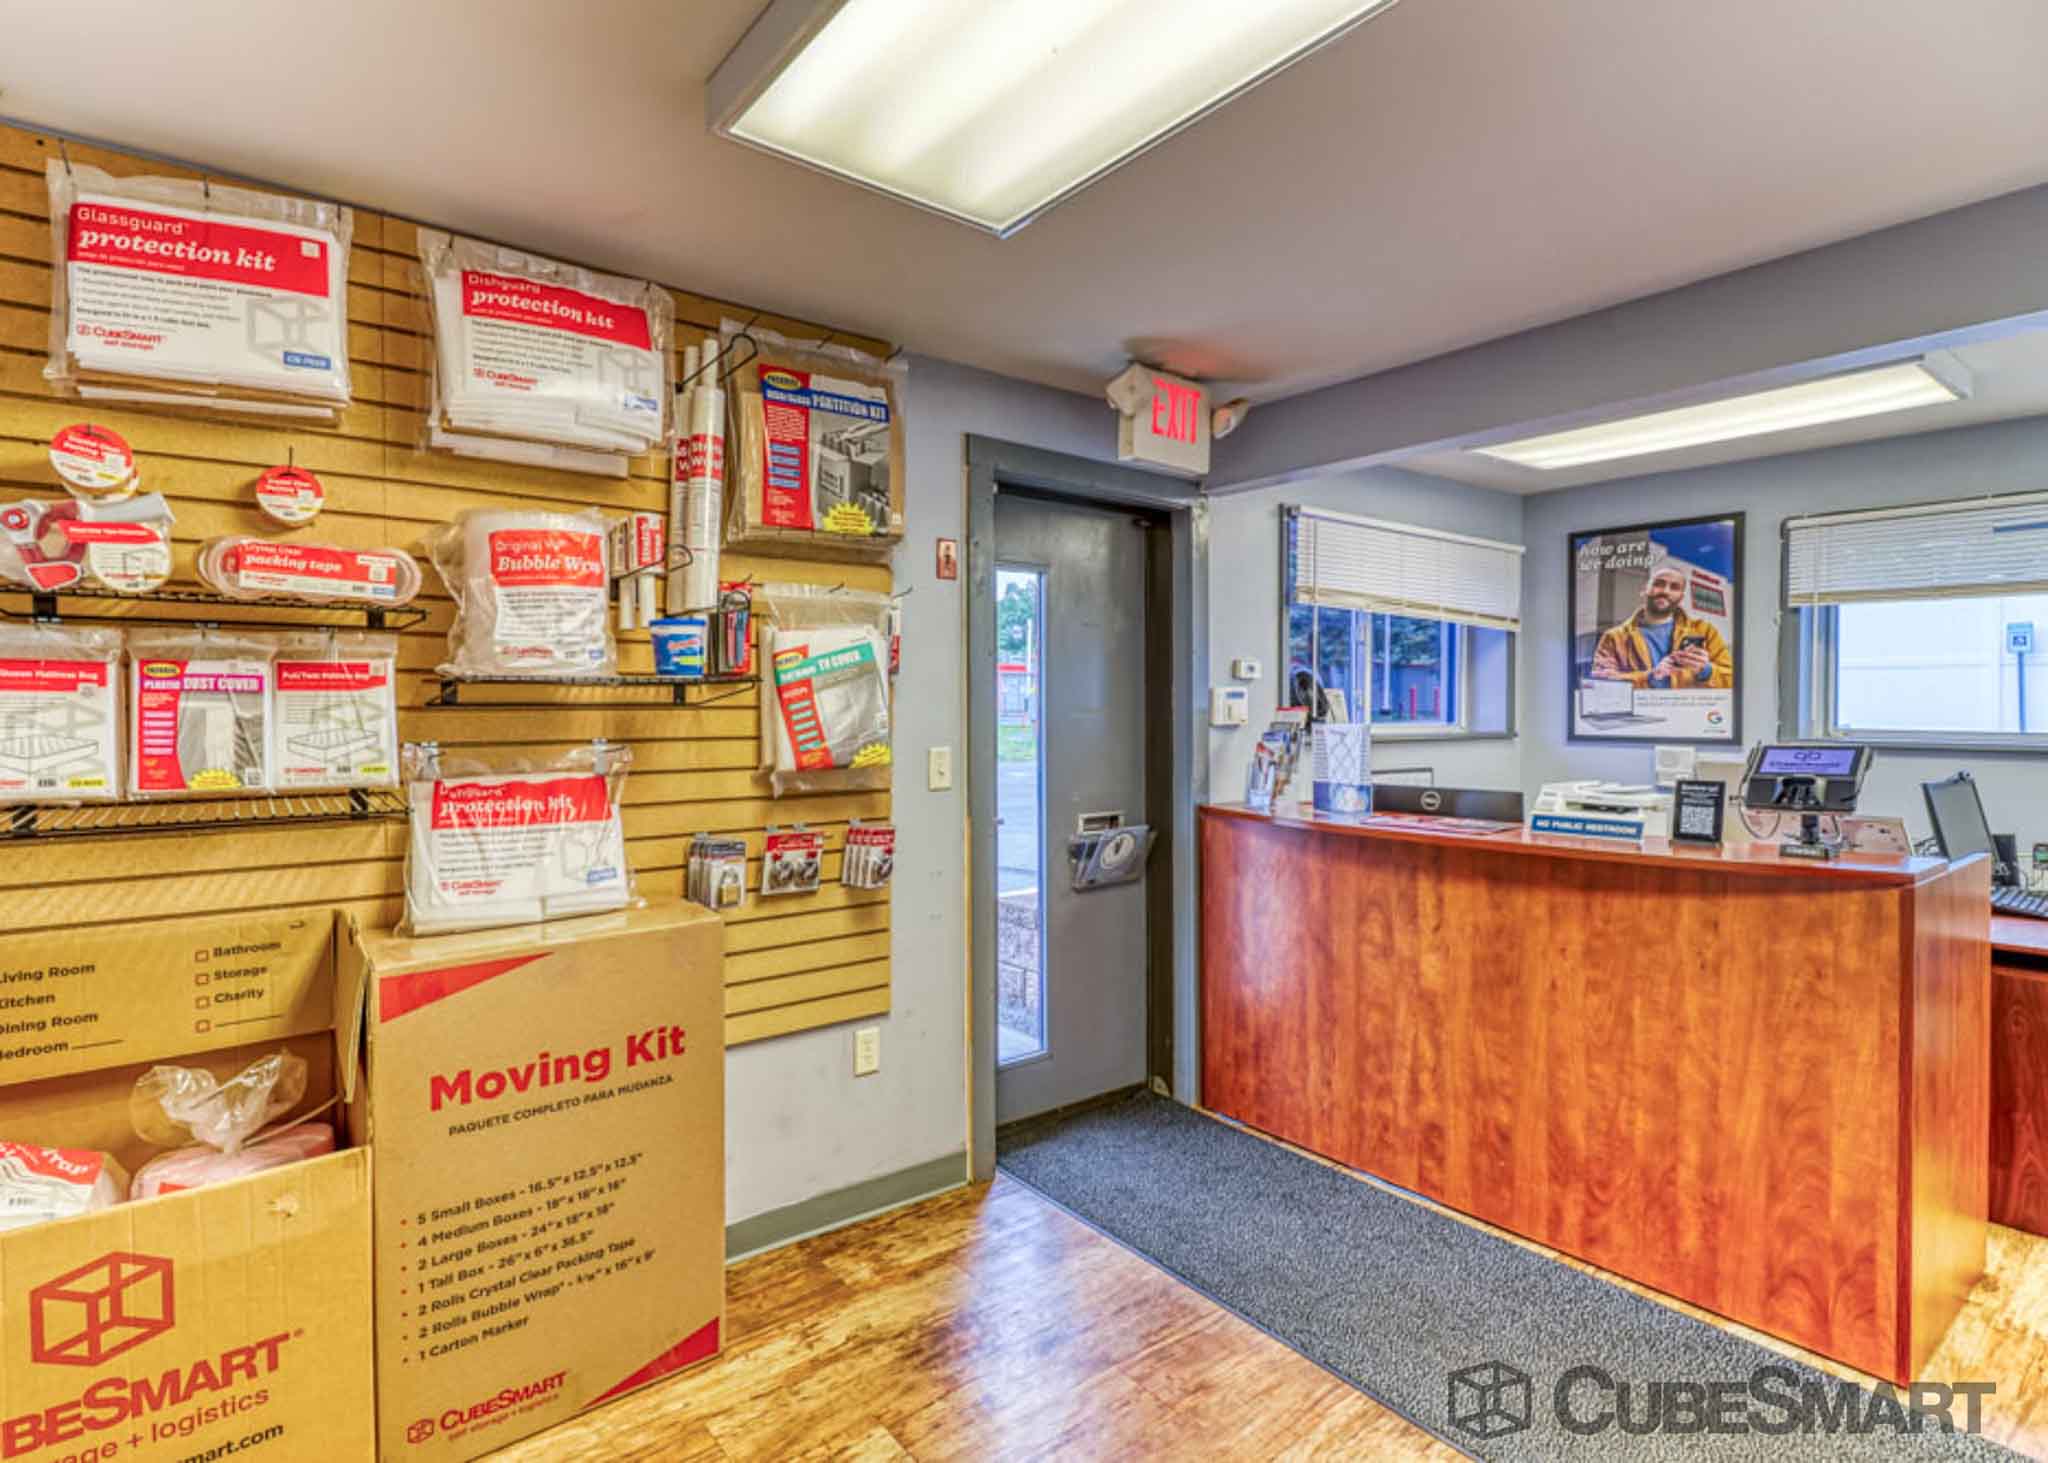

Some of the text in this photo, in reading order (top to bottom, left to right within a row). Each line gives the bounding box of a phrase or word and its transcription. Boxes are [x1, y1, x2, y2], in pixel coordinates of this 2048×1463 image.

[77, 207, 184, 235] Glassguard
[78, 229, 231, 265] protection
[236, 247, 277, 271] kit
[472, 290, 582, 320] protection
[585, 310, 616, 328] kit
[1151, 376, 1201, 445] EXIT
[244, 554, 343, 573] packing tape
[497, 556, 561, 572] Bubble
[183, 678, 215, 690] DUST
[217, 678, 260, 691] COVER
[438, 795, 546, 817] protection
[1552, 821, 1584, 831] PUBLIC
[212, 941, 281, 958] Bathroom
[0, 964, 96, 984] iving Room
[213, 965, 268, 981] Storage
[214, 987, 264, 1004] Charity
[52, 1013, 99, 1028] Room
[0, 1042, 69, 1060] edroom
[429, 1025, 686, 1112] Moving Kit
[448, 1074, 674, 1137] PAQUETE COMPLETO PARA MUDANZA
[417, 1215, 426, 1227] 5
[432, 1202, 470, 1223] Small
[475, 1189, 516, 1211] Boxes
[418, 1236, 427, 1248] 4
[432, 1217, 489, 1245] Medium
[493, 1205, 533, 1227] Boxes
[418, 1259, 426, 1271] 2
[432, 1245, 472, 1268] Large
[477, 1231, 517, 1254] Boxes
[418, 1236, 635, 1317] 2 Rolls Crystal Clear Packing Tape
[419, 1282, 424, 1293] 1
[429, 1273, 453, 1290] Tall
[458, 1264, 484, 1282] Box
[419, 1327, 428, 1339] 2
[433, 1314, 467, 1334] Rolls
[472, 1297, 520, 1322] Bubble
[419, 1315, 529, 1361] 1 Carton Marker
[152, 1389, 269, 1443] logistics
[440, 1370, 567, 1430] CUBESMART
[178, 1424, 284, 1463] mart.com
